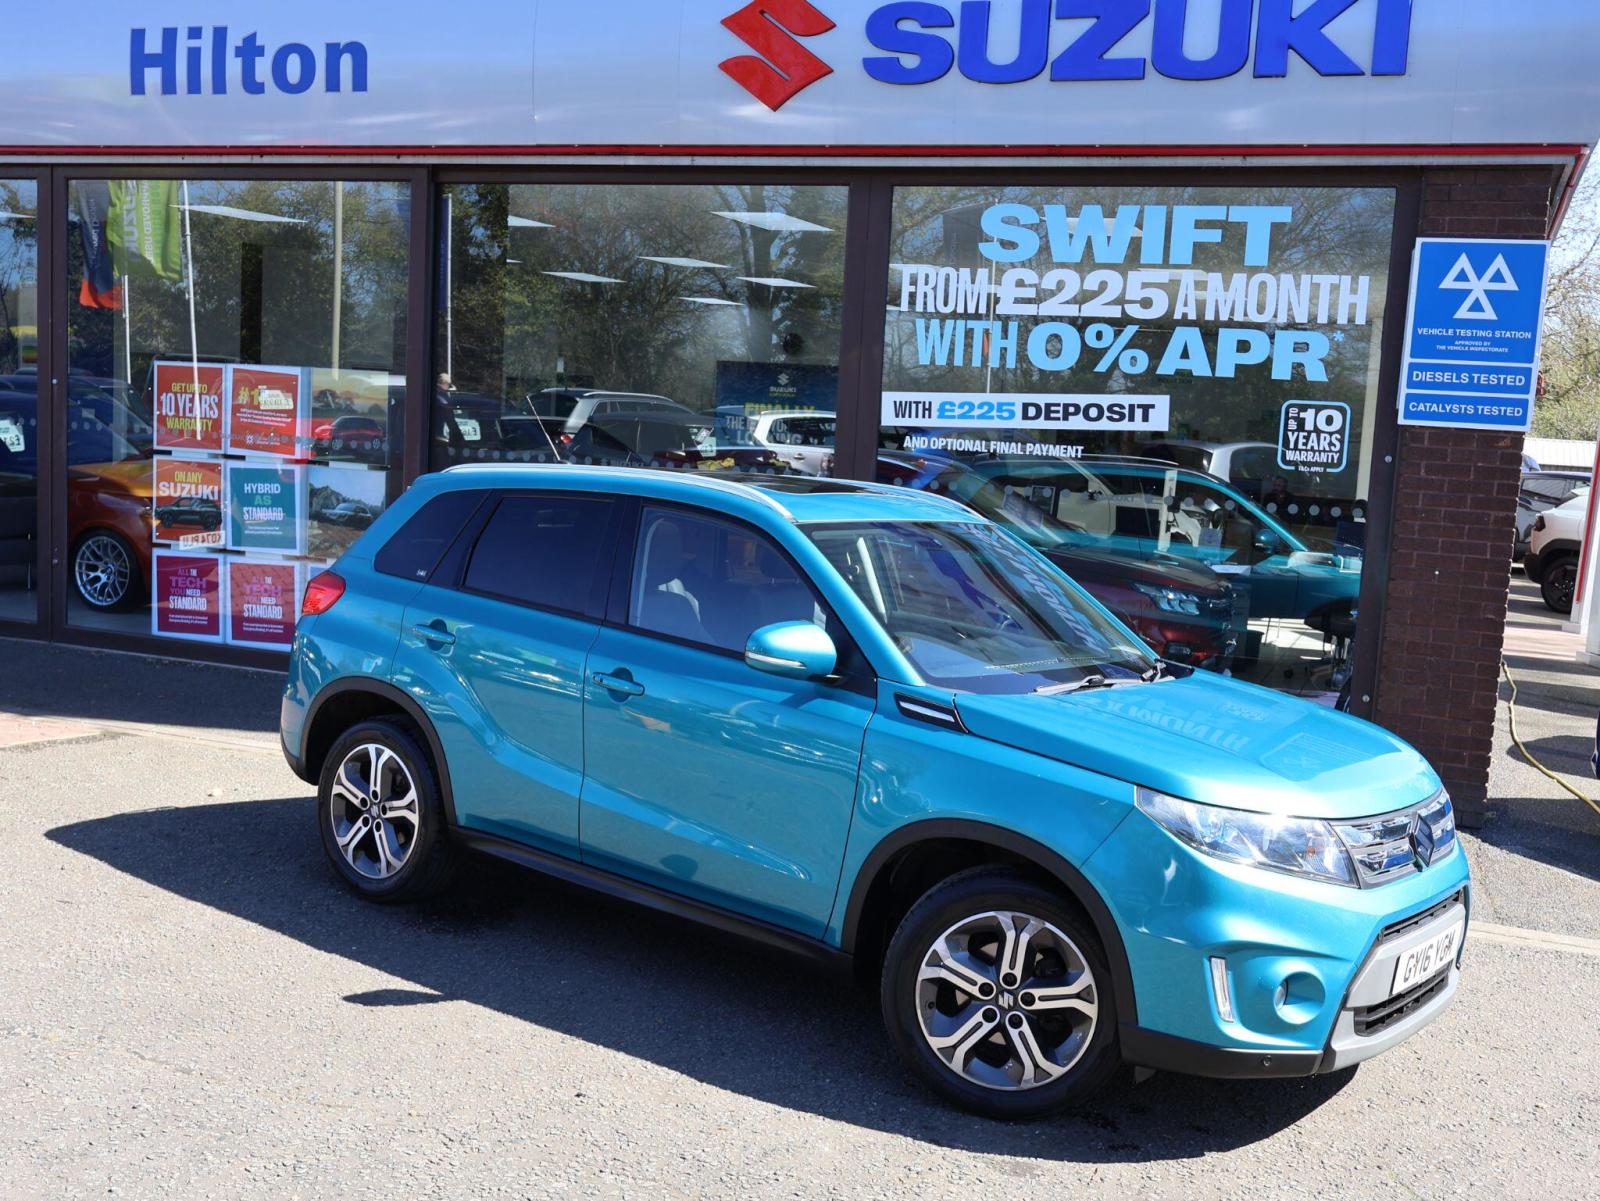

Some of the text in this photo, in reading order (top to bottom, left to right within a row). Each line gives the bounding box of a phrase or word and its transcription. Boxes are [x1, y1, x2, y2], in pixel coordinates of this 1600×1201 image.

[862, 0, 1413, 85] SUZUKI
[130, 26, 368, 96] Hilton
[978, 203, 1293, 267] SWIFT
[900, 264, 1371, 325] FROM £225 A MONTH
[1417, 327, 1532, 340] VEHICLE TESTING STATION
[915, 318, 1019, 369] WITH
[1027, 321, 1152, 376] 0%
[1412, 370, 1526, 387] DIESELS TESTED
[171, 382, 186, 393] GET
[160, 392, 175, 417] 10
[177, 393, 219, 419] YEARS
[893, 400, 1156, 423] WITH £225 DEPOSIT
[1409, 402, 1523, 417] CATALYSTS TESTED
[726, 416, 745, 430] THE
[1287, 407, 1299, 430] UP TO
[1299, 408, 1343, 432] 10
[903, 435, 1085, 458] AND OPTIONAL FINAL PAYMENT
[1287, 431, 1342, 452] YEARS
[1285, 450, 1340, 463] WARRANTY
[174, 471, 202, 484] ON ANY
[158, 481, 219, 501] SUZUKI
[244, 483, 281, 494] HYBRID
[254, 495, 272, 506] AS
[243, 507, 283, 521] STANDARD
[169, 577, 207, 588] TECH
[186, 589, 201, 597] NEED
[169, 596, 207, 611] STANDARD
[243, 604, 283, 619] STANDARD
[1403, 943, 1434, 983] GY16
